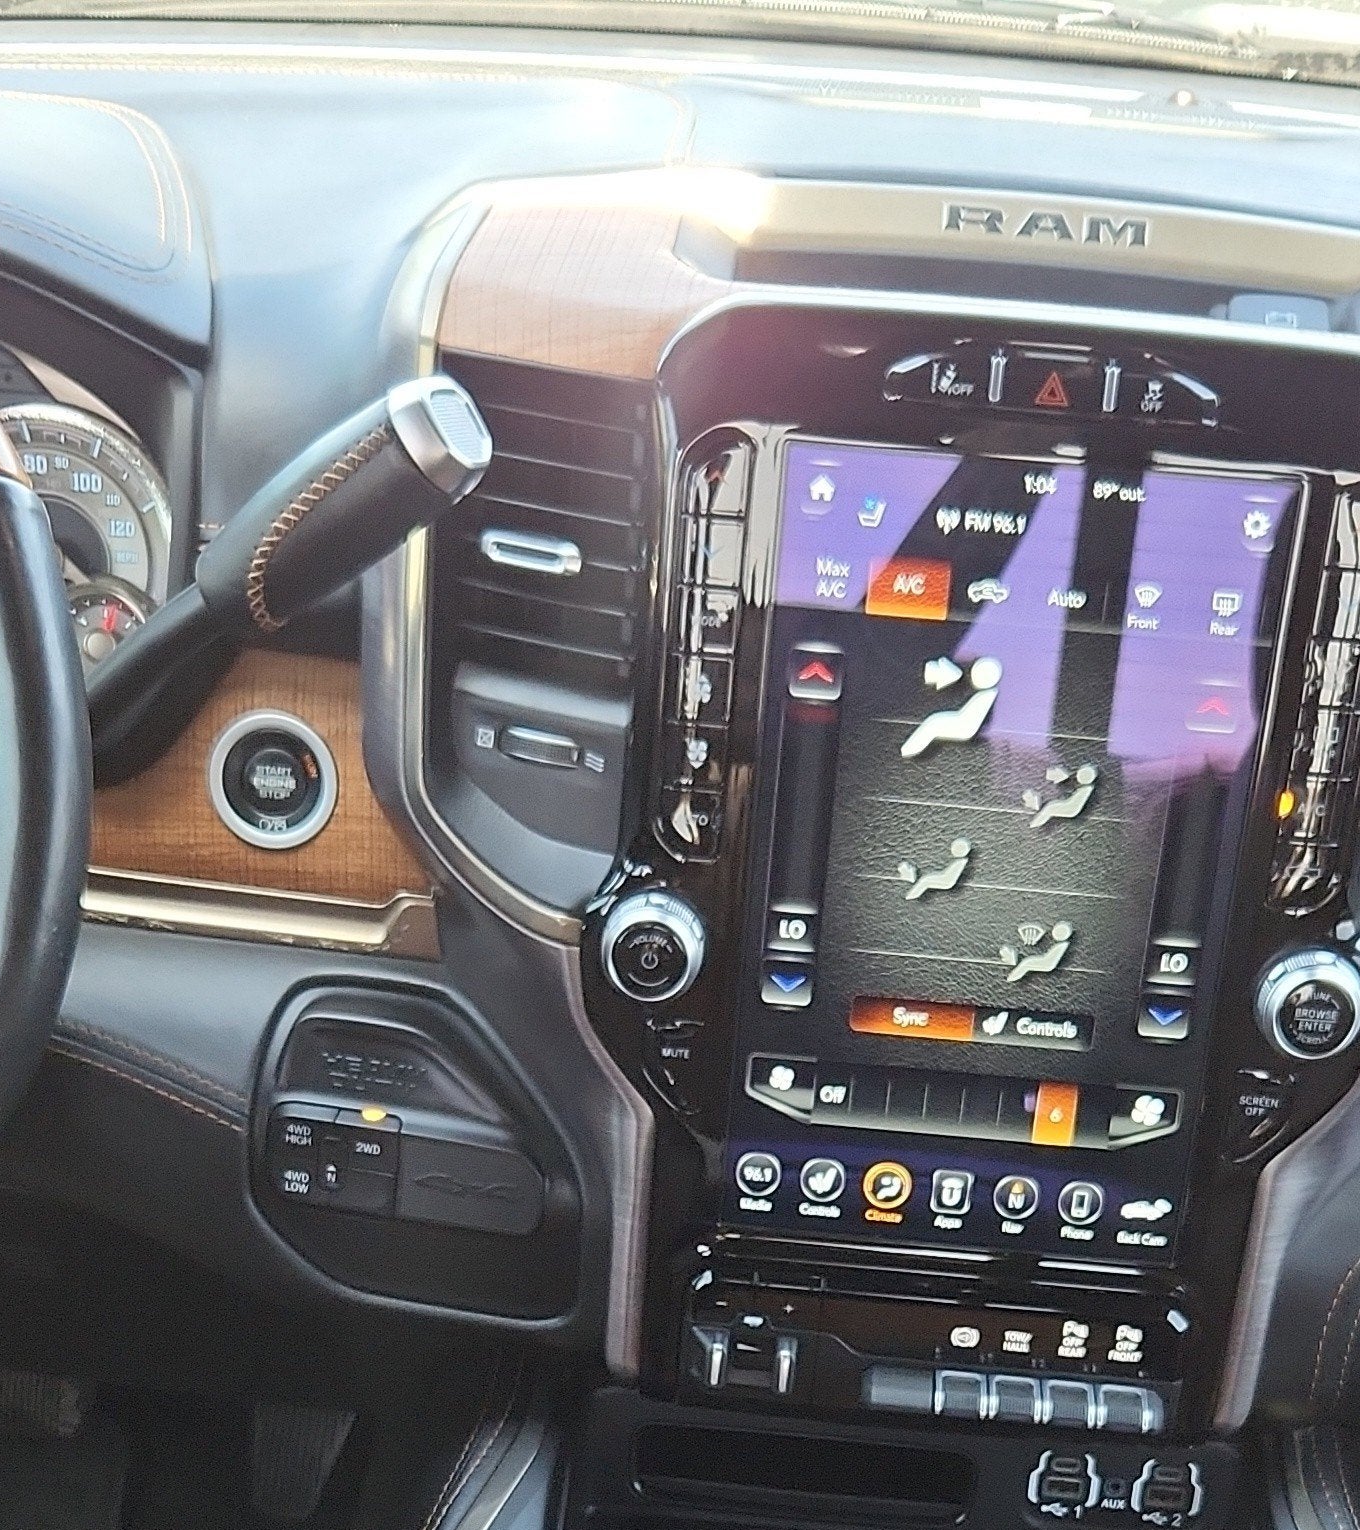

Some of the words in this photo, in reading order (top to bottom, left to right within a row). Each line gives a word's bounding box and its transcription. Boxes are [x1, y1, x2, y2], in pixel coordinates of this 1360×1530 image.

[941, 203, 1148, 248] RAM
[72, 471, 103, 494] 100
[110, 518, 136, 538] 120
[815, 555, 851, 578] Max
[815, 578, 848, 600] A/C
[892, 572, 927, 595] A/C
[1048, 588, 1087, 610] Auto
[1126, 615, 1160, 632] Front
[1210, 620, 1240, 637] Rear
[256, 765, 293, 777] START
[779, 918, 807, 940] LO
[1160, 952, 1189, 973] LO
[892, 1006, 930, 1027] Sync
[1295, 1007, 1339, 1020] BROWSE
[1016, 1016, 1078, 1039] Controls
[1297, 1021, 1332, 1032] ENTER
[661, 1048, 690, 1059] MUTE
[819, 1085, 847, 1104] Off
[1240, 1095, 1280, 1109] SCREEN
[1049, 1107, 1064, 1123] 6
[1244, 1108, 1266, 1117] OFF
[286, 1123, 312, 1137] 4WD
[285, 1134, 313, 1147] HIGH
[355, 1142, 382, 1156] 2WD
[283, 1169, 310, 1183] 4WD
[326, 1172, 338, 1183] N
[284, 1180, 310, 1194] LOW
[864, 1208, 903, 1224] Climate
[933, 1214, 963, 1229] Apps
[1060, 1224, 1095, 1241] Phone
[1073, 1504, 1083, 1519] 1
[1100, 1498, 1126, 1510] AUX
[1171, 1513, 1183, 1527] 2
